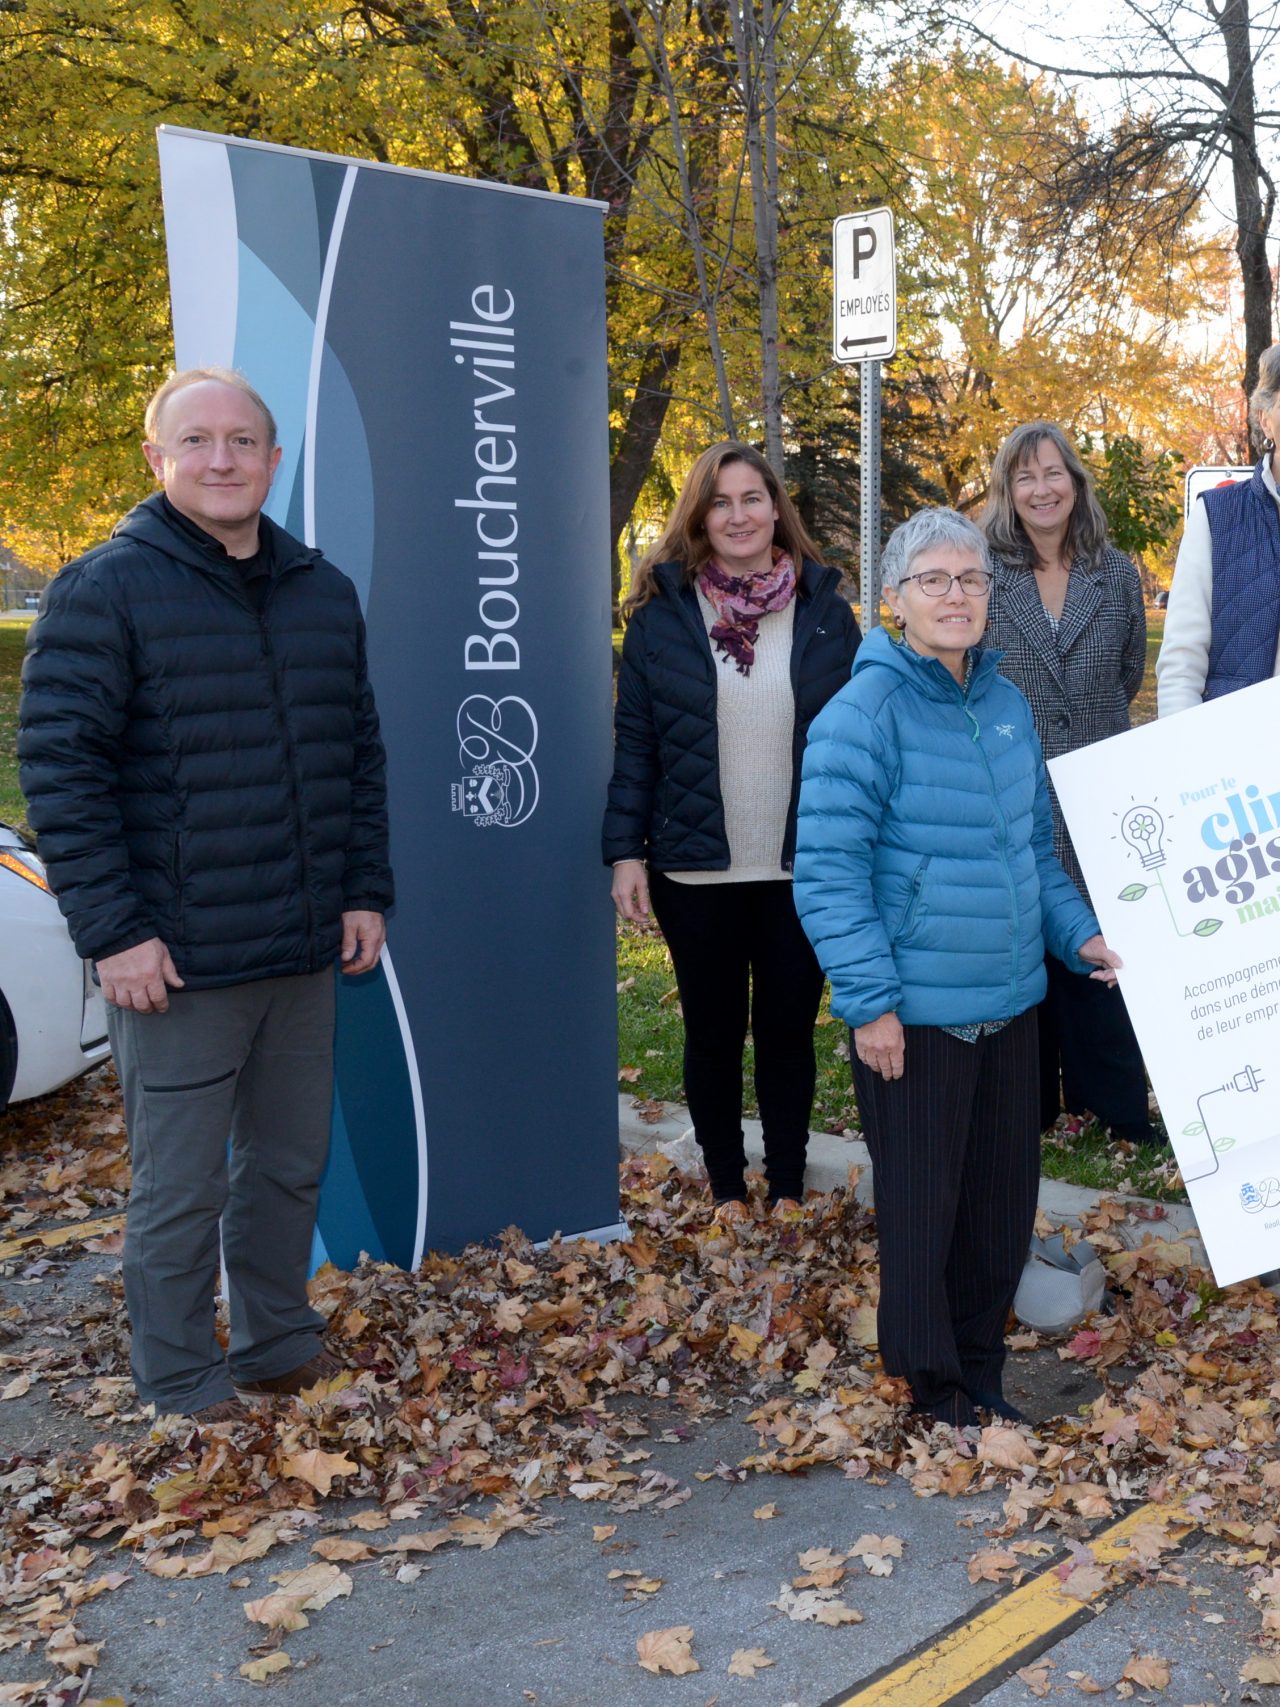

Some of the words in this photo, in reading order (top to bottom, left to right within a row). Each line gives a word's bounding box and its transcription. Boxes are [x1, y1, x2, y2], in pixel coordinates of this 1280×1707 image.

[853, 227, 877, 280] P
[840, 292, 890, 317] EMPLOYÉS
[449, 284, 520, 671] Boucherville
[1178, 786, 1219, 807] Pour
[1220, 776, 1237, 795] le
[1190, 1001, 1222, 1021] dans
[1223, 992, 1249, 1009] une
[1197, 1025, 1215, 1041] de
[1216, 1014, 1242, 1034] leur
